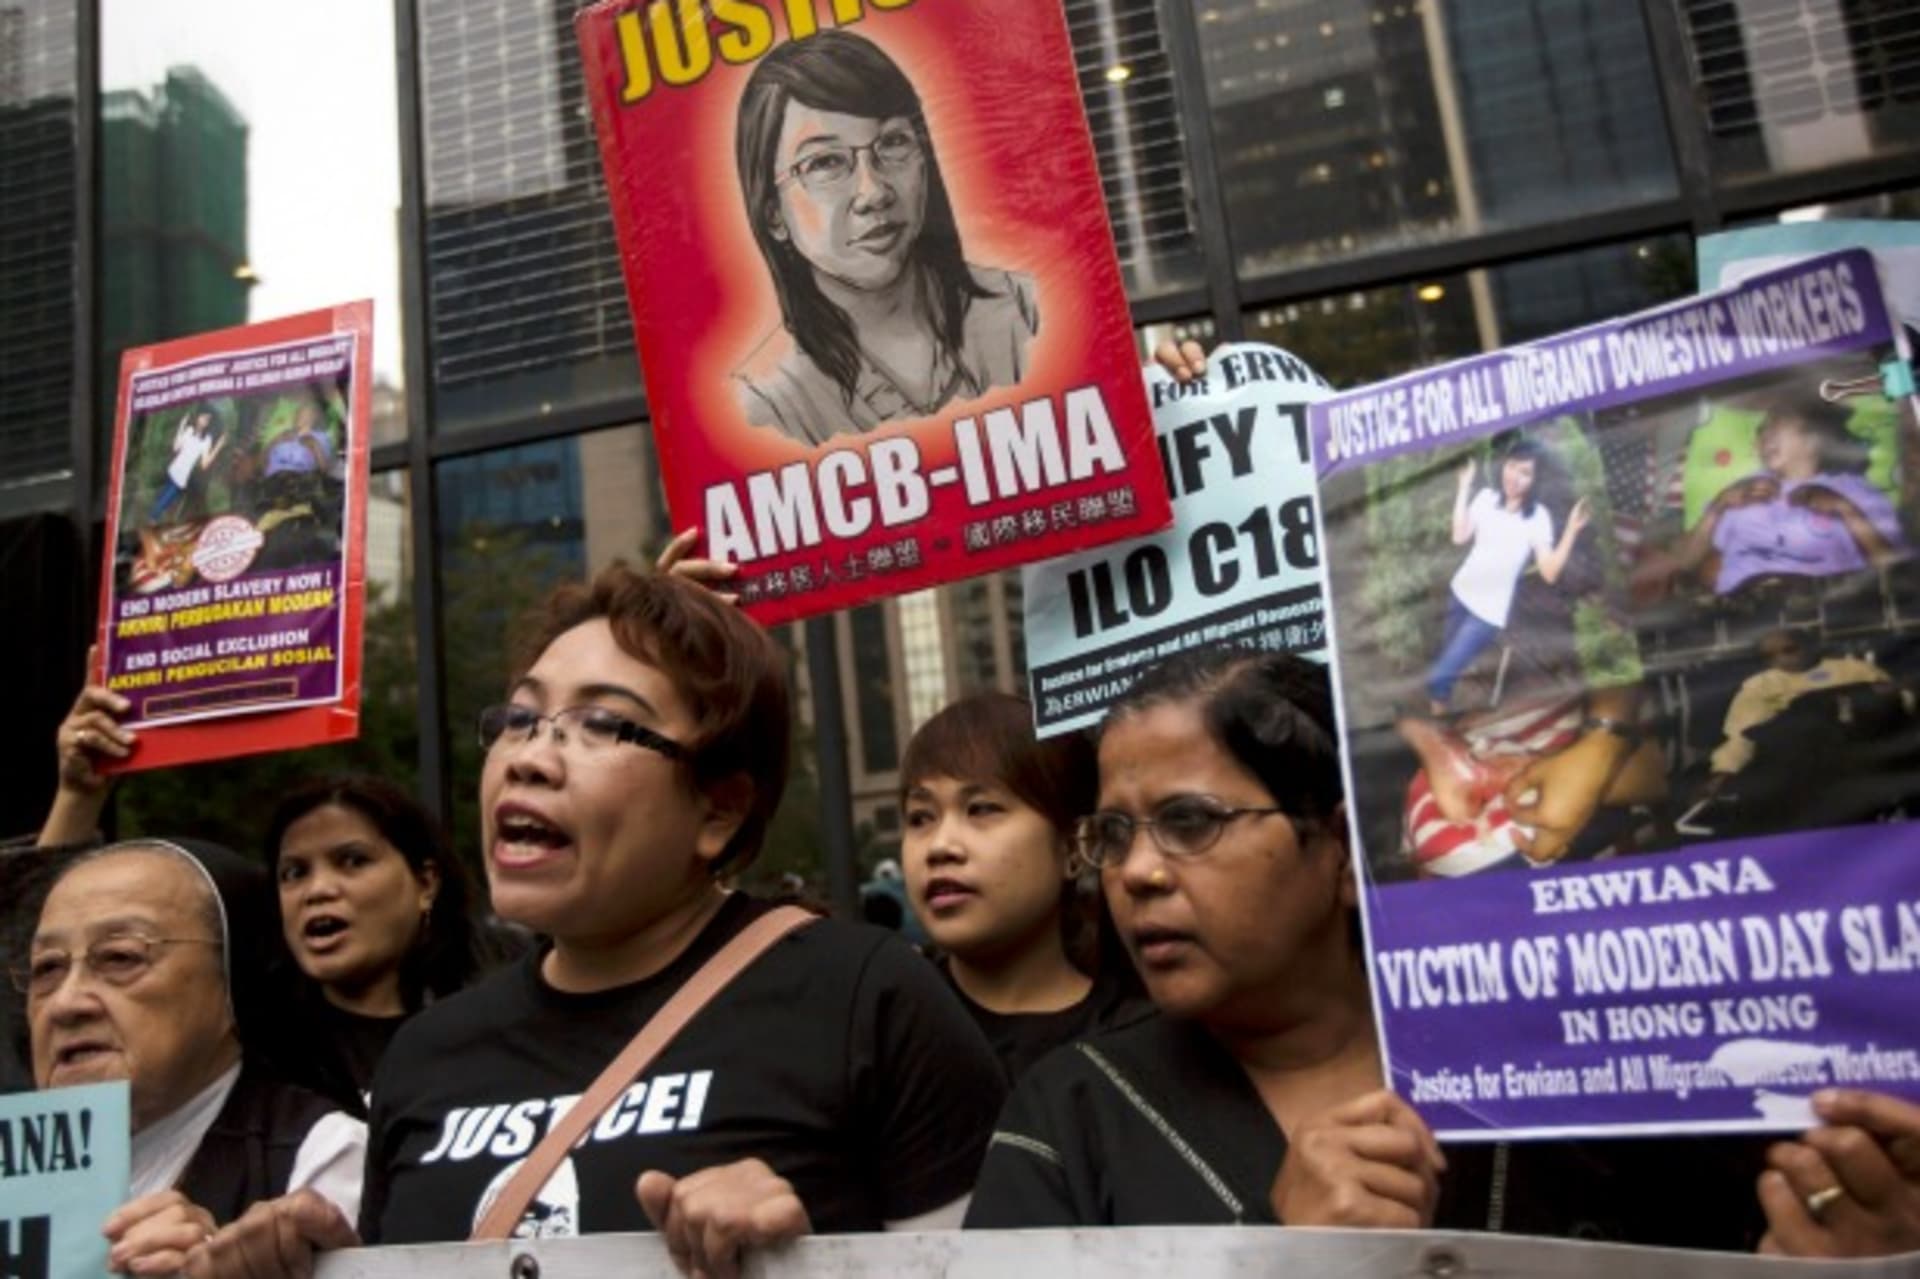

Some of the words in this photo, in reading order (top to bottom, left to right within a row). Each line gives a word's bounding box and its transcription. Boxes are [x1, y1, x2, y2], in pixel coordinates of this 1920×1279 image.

[1326, 387, 1412, 461] JUSTICE
[1411, 377, 1458, 440] FOR
[1459, 366, 1502, 427] ALL
[1501, 337, 1606, 416] MIGRANT
[1605, 302, 1735, 390] DOMESTIC
[1726, 261, 1867, 360] WORKERS
[704, 384, 1127, 564] AMCB-IMA
[118, 615, 168, 638] AKHIRI
[268, 588, 334, 615] MODERN
[121, 598, 150, 617] END
[153, 587, 209, 612] MODERN
[214, 577, 284, 602] SLAVERY
[286, 571, 322, 592] NOW
[1066, 544, 1173, 640] ILO
[108, 670, 162, 689] AKHIRI
[165, 653, 268, 683] PENGUCILAN
[271, 645, 335, 667] SOSIAL
[126, 652, 156, 670] END
[161, 641, 212, 666] SOCIAL
[217, 629, 309, 655] EXCLUSION
[1085, 662, 1103, 679] for
[1157, 635, 1181, 657] and
[1182, 630, 1202, 648] All
[1203, 612, 1255, 642] Migrant
[1529, 856, 1775, 914] ERWIANA
[1378, 941, 1508, 1009] VICTIM
[1511, 936, 1560, 999] OF
[1565, 918, 1740, 994] MODERN
[1740, 910, 1832, 981] DAY
[1841, 902, 1920, 974] SLA
[1559, 1008, 1600, 1044] IN
[1606, 1002, 1706, 1041] HONG
[1709, 994, 1818, 1035] KONG
[1410, 1068, 1473, 1103] Justice
[1474, 1064, 1501, 1099] for
[1502, 1060, 1579, 1098] Erwiana
[1580, 1057, 1619, 1094] and
[1620, 1055, 1649, 1093] All
[420, 1070, 714, 1164] JUSTCE!
